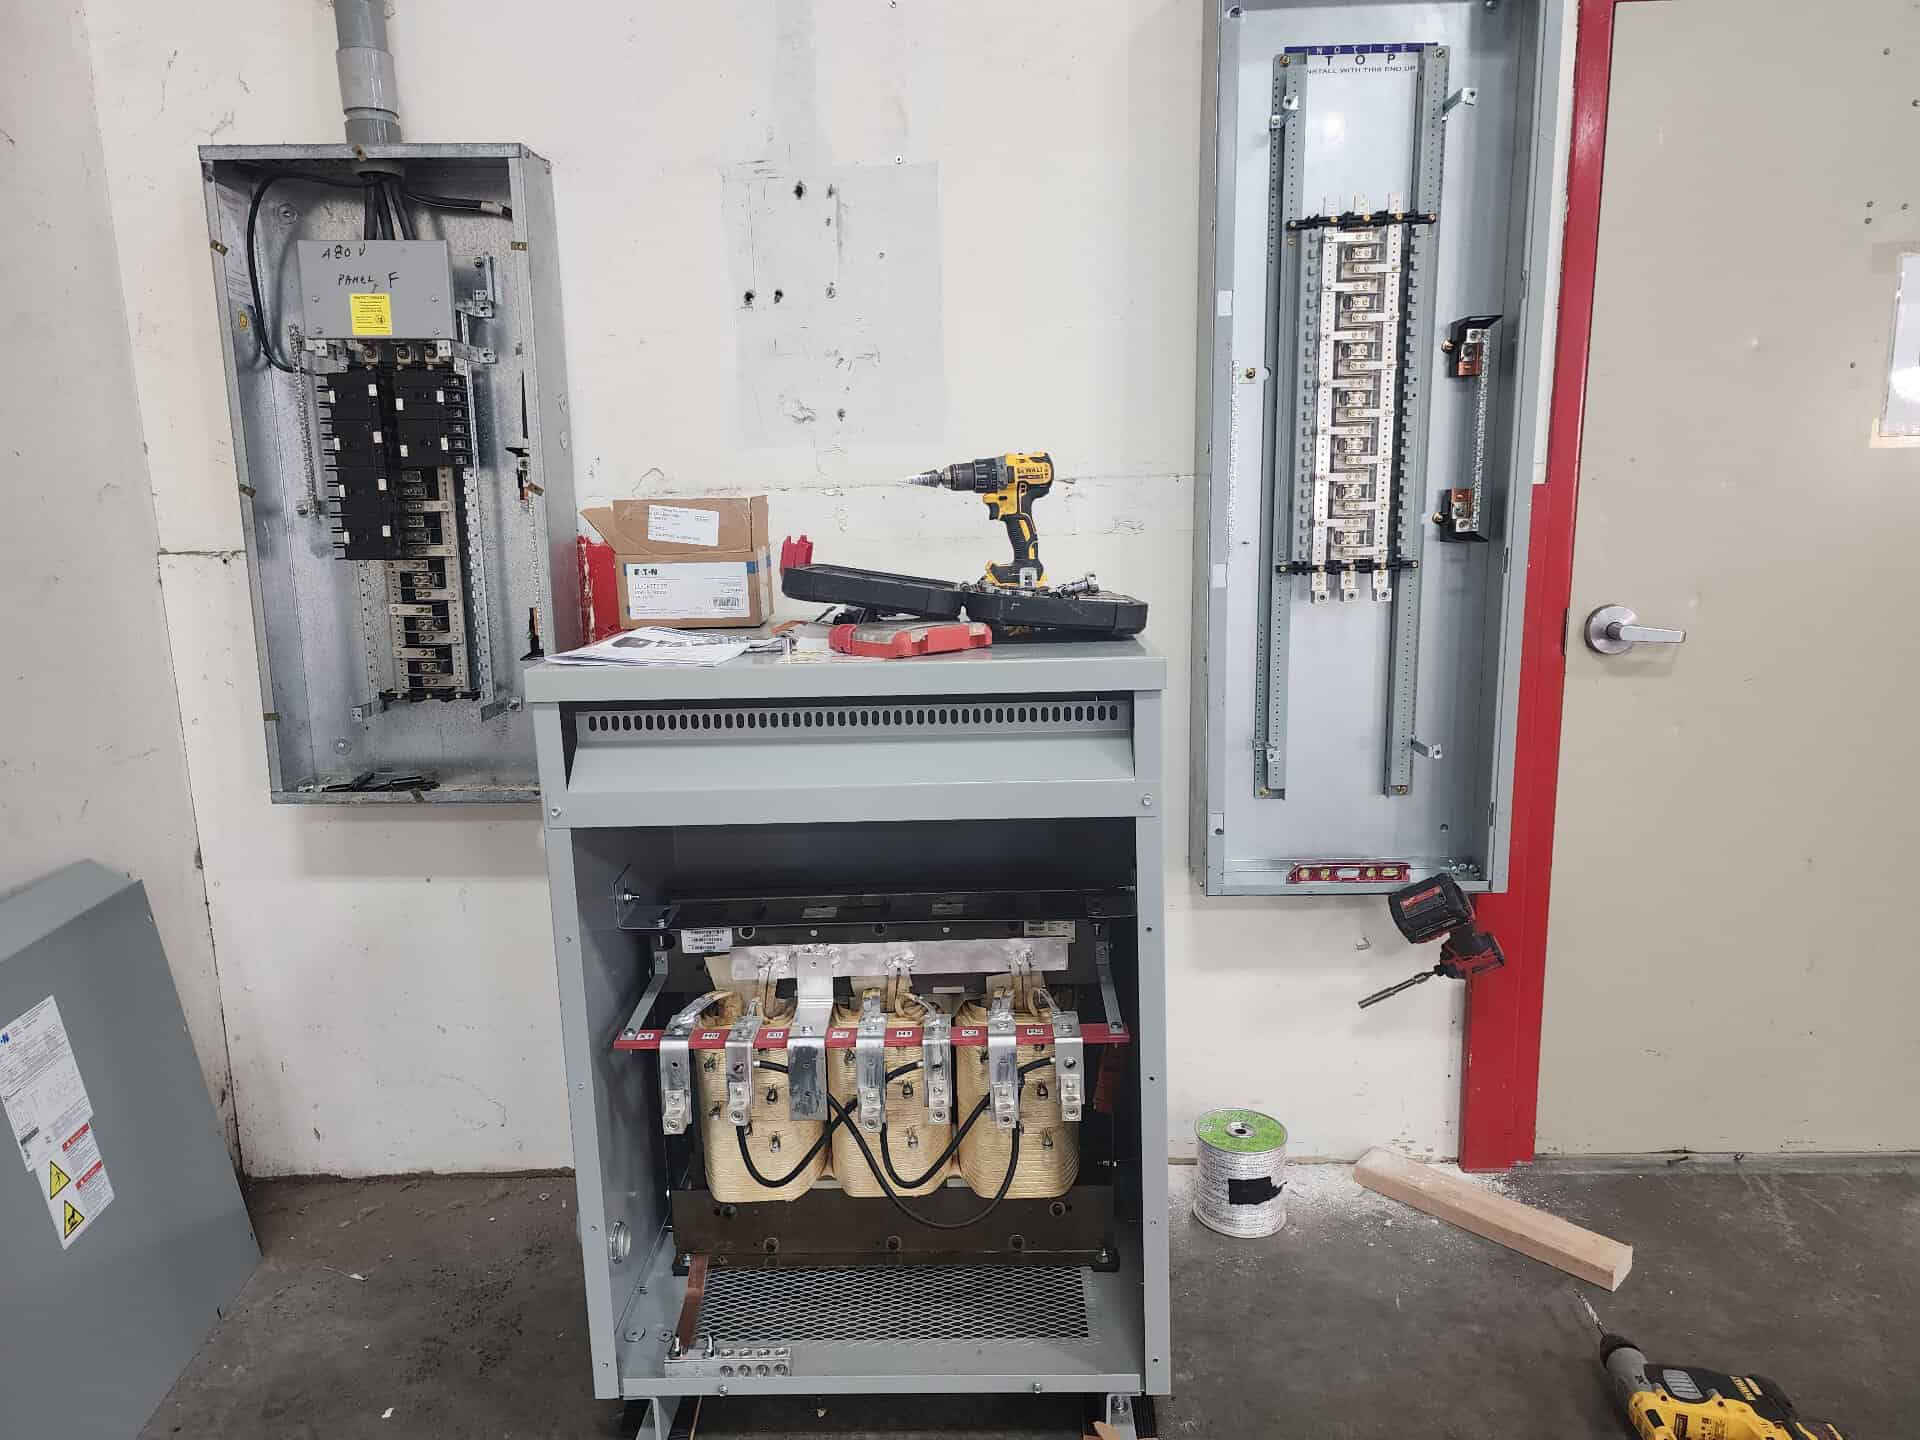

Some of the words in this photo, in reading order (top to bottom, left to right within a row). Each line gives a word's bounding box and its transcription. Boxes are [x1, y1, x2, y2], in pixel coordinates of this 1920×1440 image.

[1316, 43, 1408, 55] NOTICE
[1325, 53, 1396, 66] TOP
[1404, 64, 1416, 72] UP
[338, 273, 374, 286] PANEL
[388, 271, 400, 288] F
